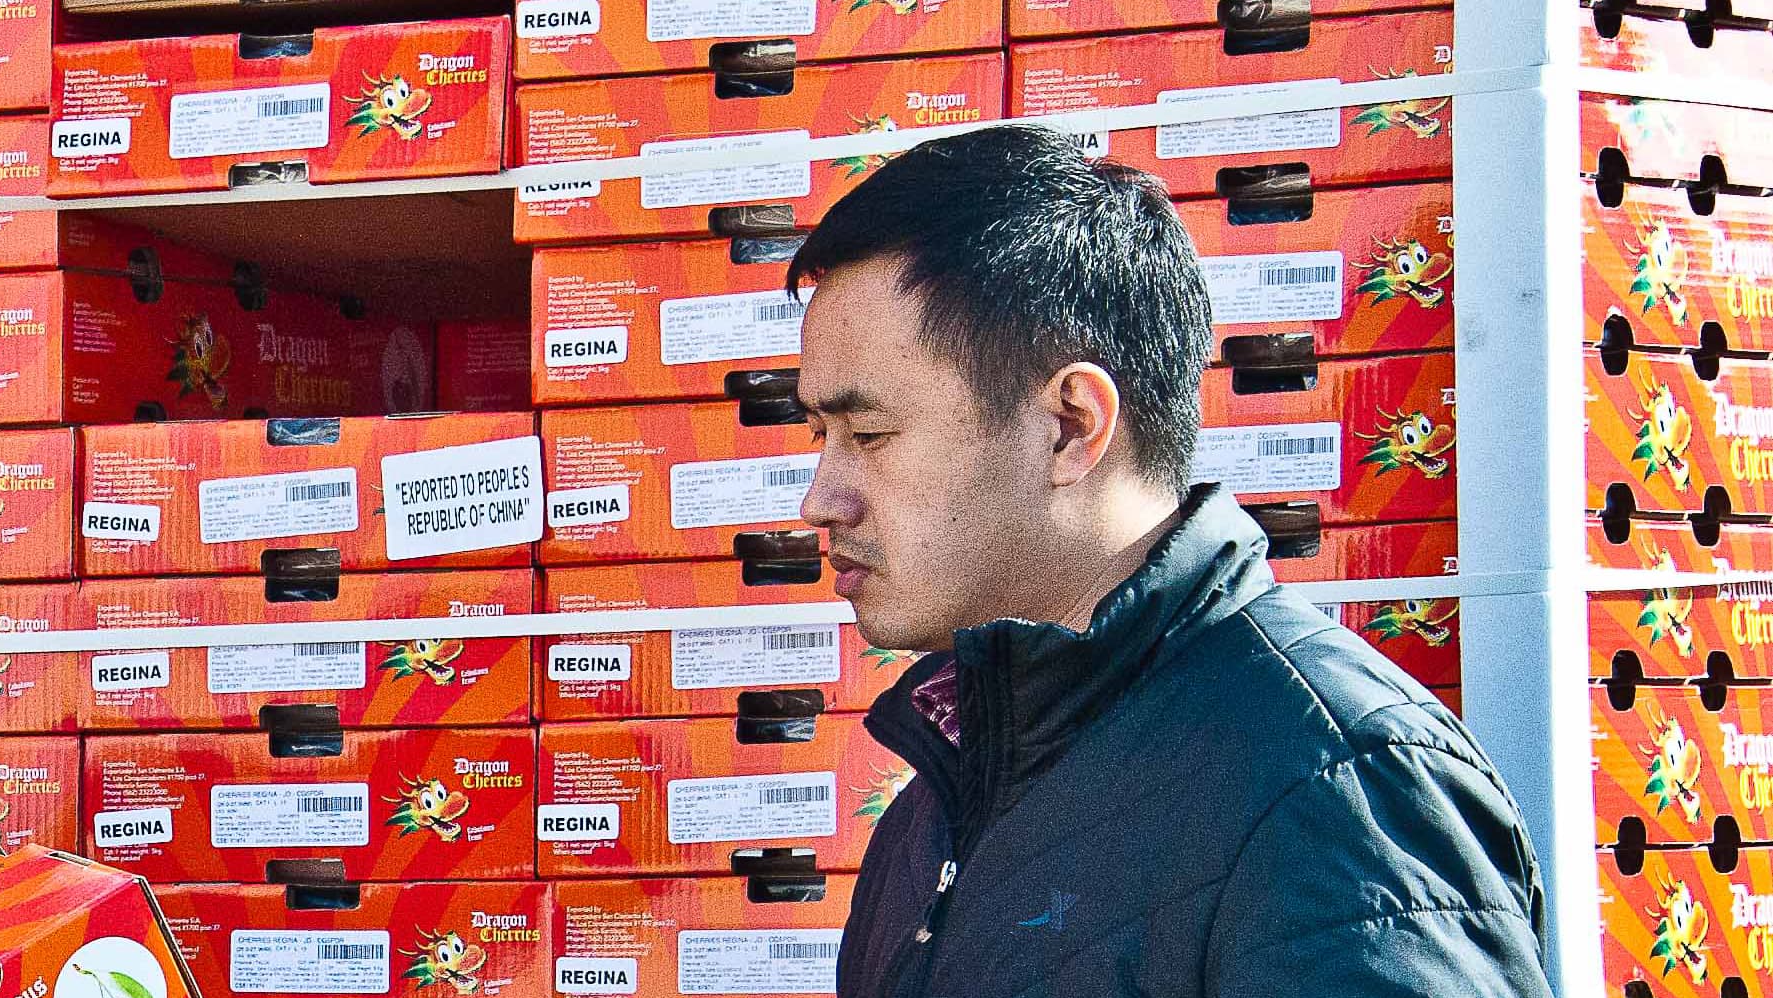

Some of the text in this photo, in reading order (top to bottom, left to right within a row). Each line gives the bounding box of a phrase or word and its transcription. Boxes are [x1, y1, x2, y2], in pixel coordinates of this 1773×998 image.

[525, 11, 591, 28] REGINA
[419, 54, 474, 72] Dragon
[426, 68, 486, 85] Cherries
[59, 132, 121, 148] REGINA
[551, 340, 617, 357] REGINA
[460, 473, 475, 496] TO
[554, 499, 620, 518] REGINA
[88, 516, 150, 532] REGINA
[408, 507, 466, 535] REPUBLIC
[469, 504, 484, 527] OF
[454, 758, 509, 774] Dragon
[462, 773, 522, 788] Cherries
[101, 821, 164, 838] REGINA
[544, 817, 609, 831] REGINA
[562, 970, 627, 984] REGINA
